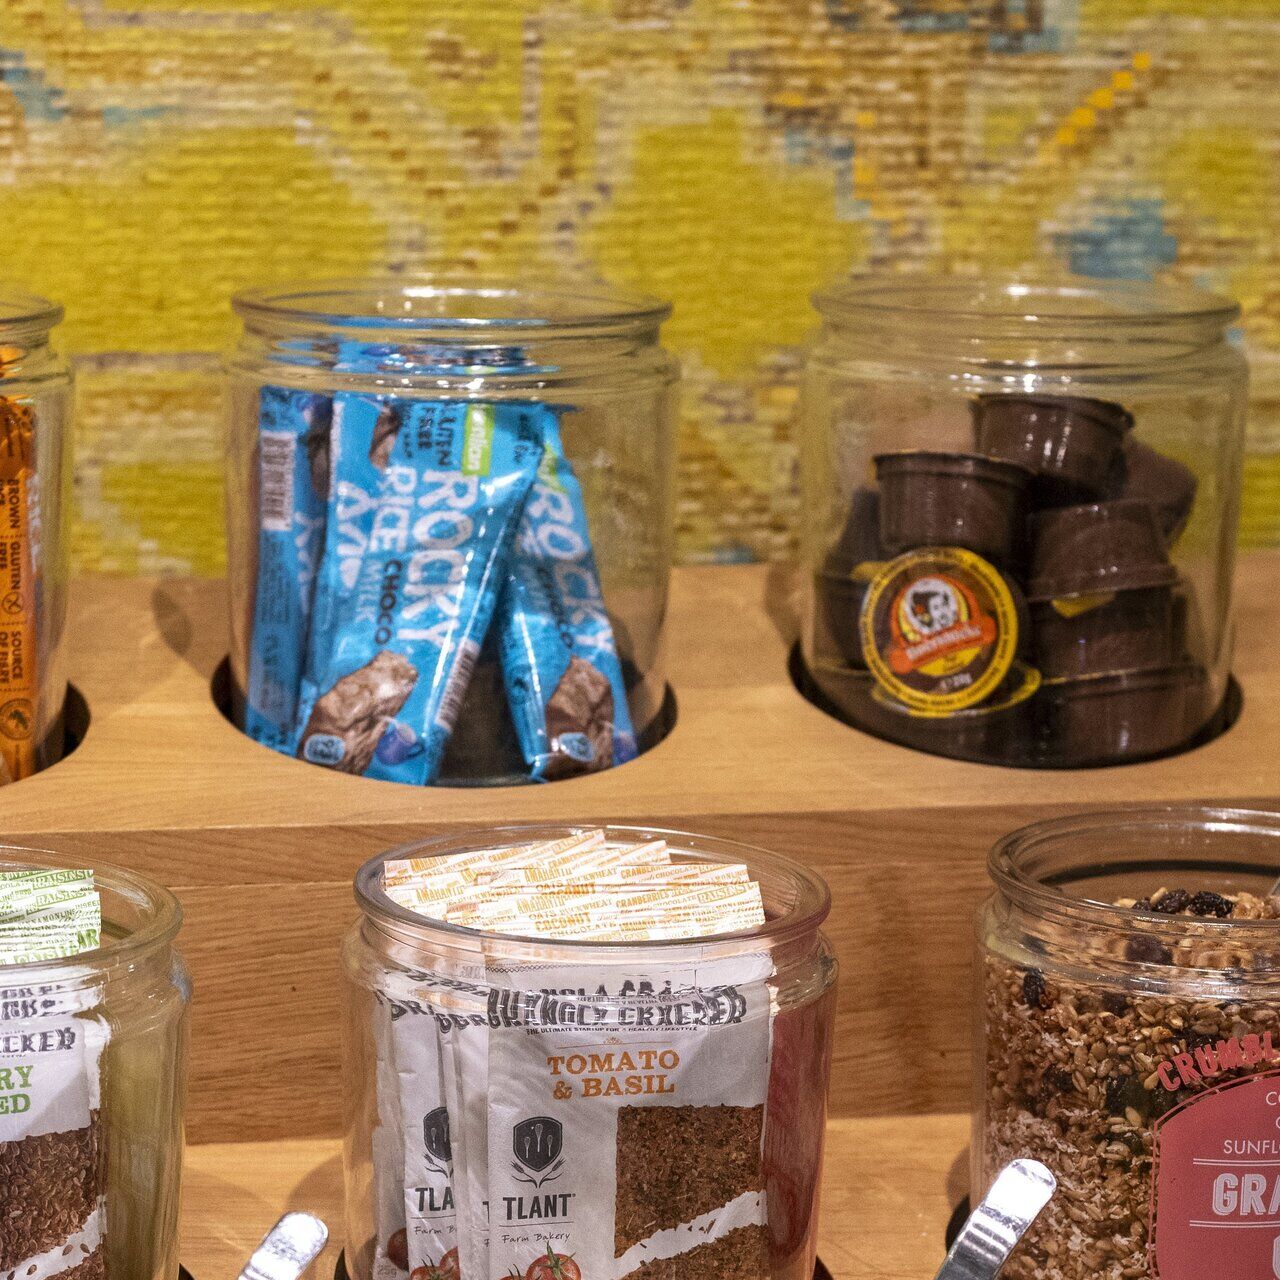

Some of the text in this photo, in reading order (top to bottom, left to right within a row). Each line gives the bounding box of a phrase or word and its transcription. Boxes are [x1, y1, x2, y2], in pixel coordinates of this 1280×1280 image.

[7, 478, 20, 529] BROWN
[370, 464, 417, 552] RICE
[9, 542, 21, 590] GLUTEN
[397, 469, 479, 651] ROCKY
[528, 483, 617, 652] ROCKY
[375, 560, 402, 645] CHOCO
[12, 630, 23, 680] SOURCE
[616, 888, 670, 908] CRANBERRIES
[534, 911, 592, 932] COCONUT
[546, 1049, 680, 1076] TOMATO
[552, 1074, 675, 1100] & BASIL
[502, 1193, 572, 1221] TLANT
[414, 1225, 443, 1236] Farm
[502, 1232, 571, 1244] Farm Bakery
